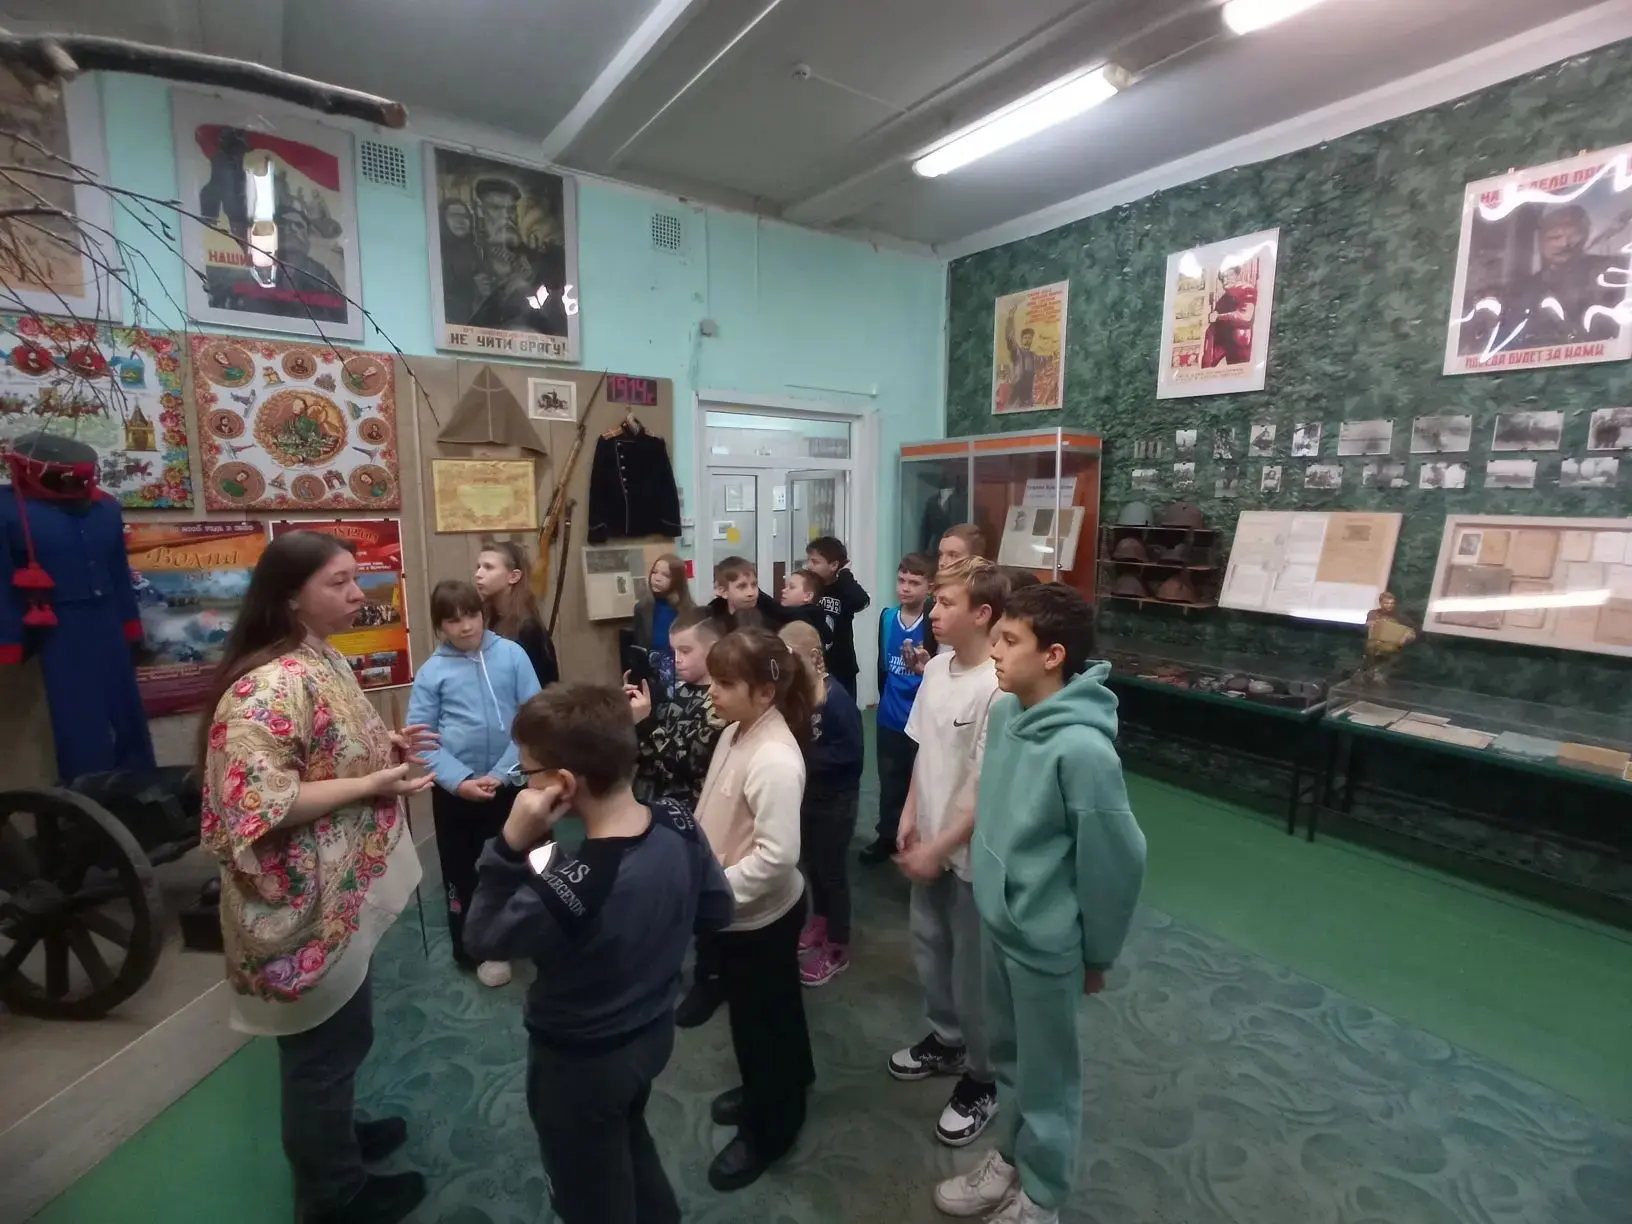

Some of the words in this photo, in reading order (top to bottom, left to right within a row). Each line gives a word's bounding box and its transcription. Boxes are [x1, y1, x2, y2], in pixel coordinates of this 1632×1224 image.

[450, 333, 469, 346] НЕ
[520, 341, 567, 355] ВРАГУ!
[1564, 344, 1605, 359] НАМИ
